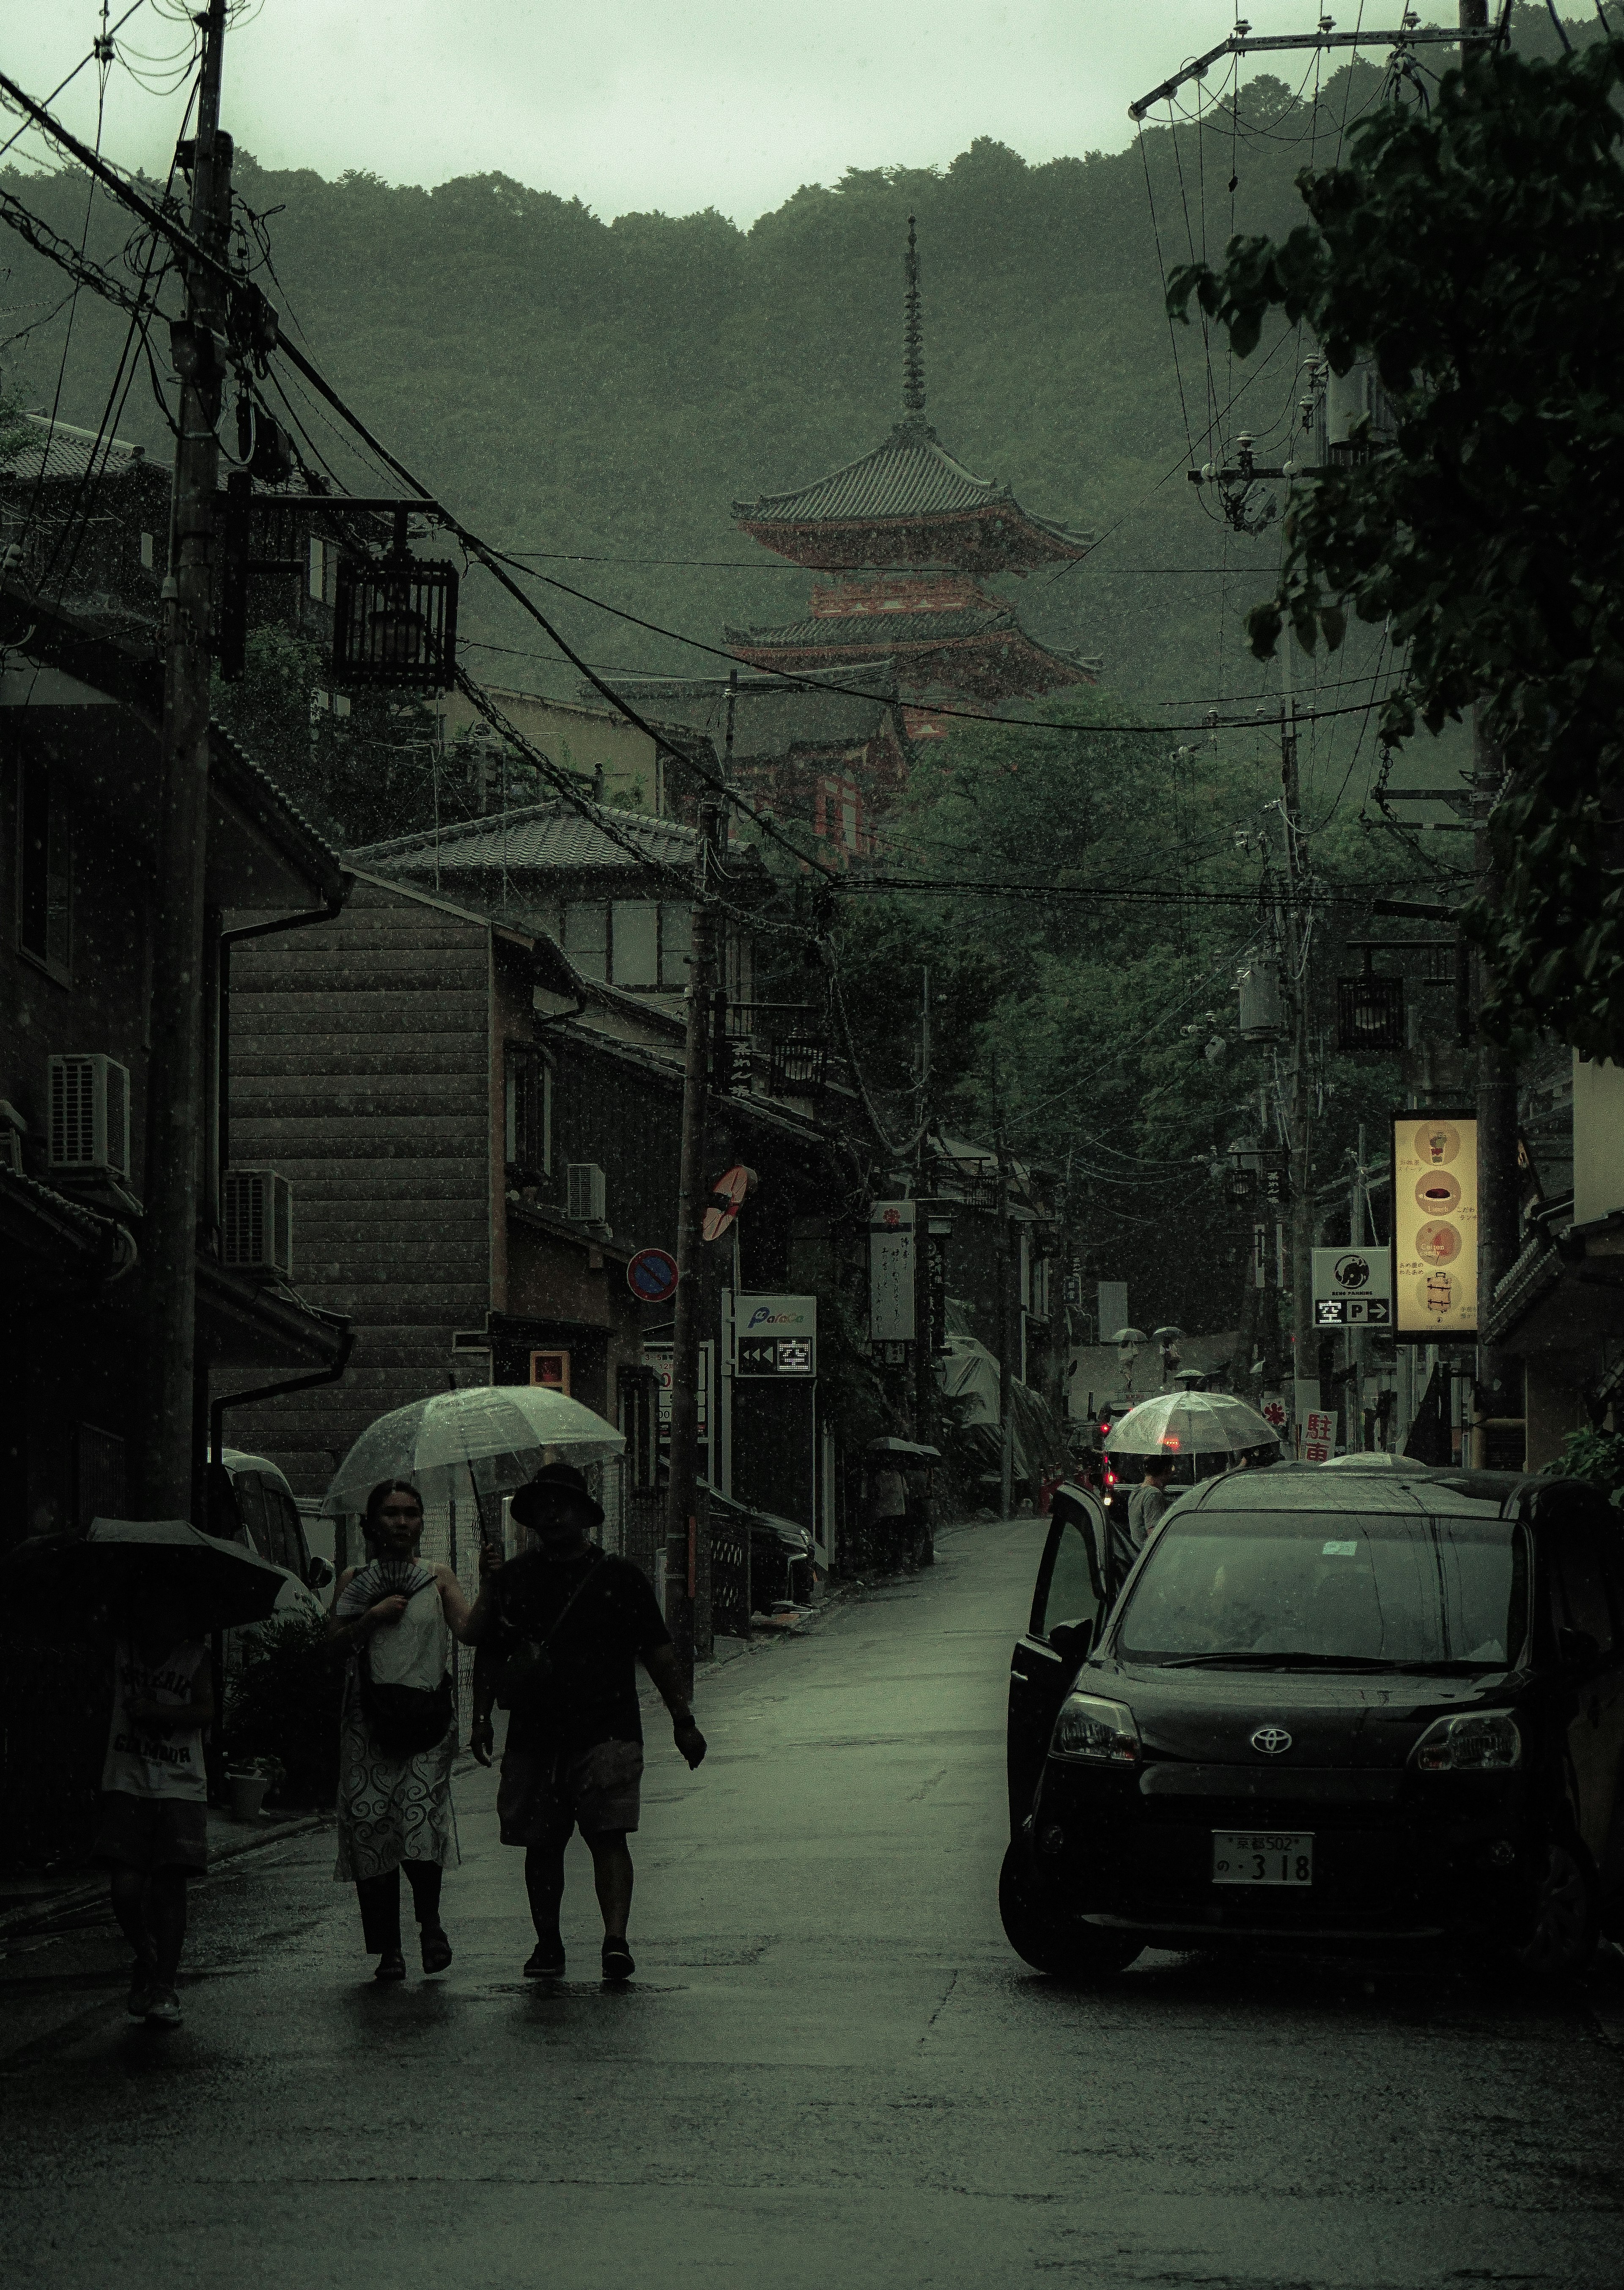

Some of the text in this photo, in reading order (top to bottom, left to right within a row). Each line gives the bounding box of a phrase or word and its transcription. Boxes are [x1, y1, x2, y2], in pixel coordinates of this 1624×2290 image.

[729, 1042, 752, 1096] 茶わん坂
[1318, 1301, 1363, 1323] 空 P
[779, 1340, 809, 1369] 空
[1306, 1414, 1332, 1462] 駐車
